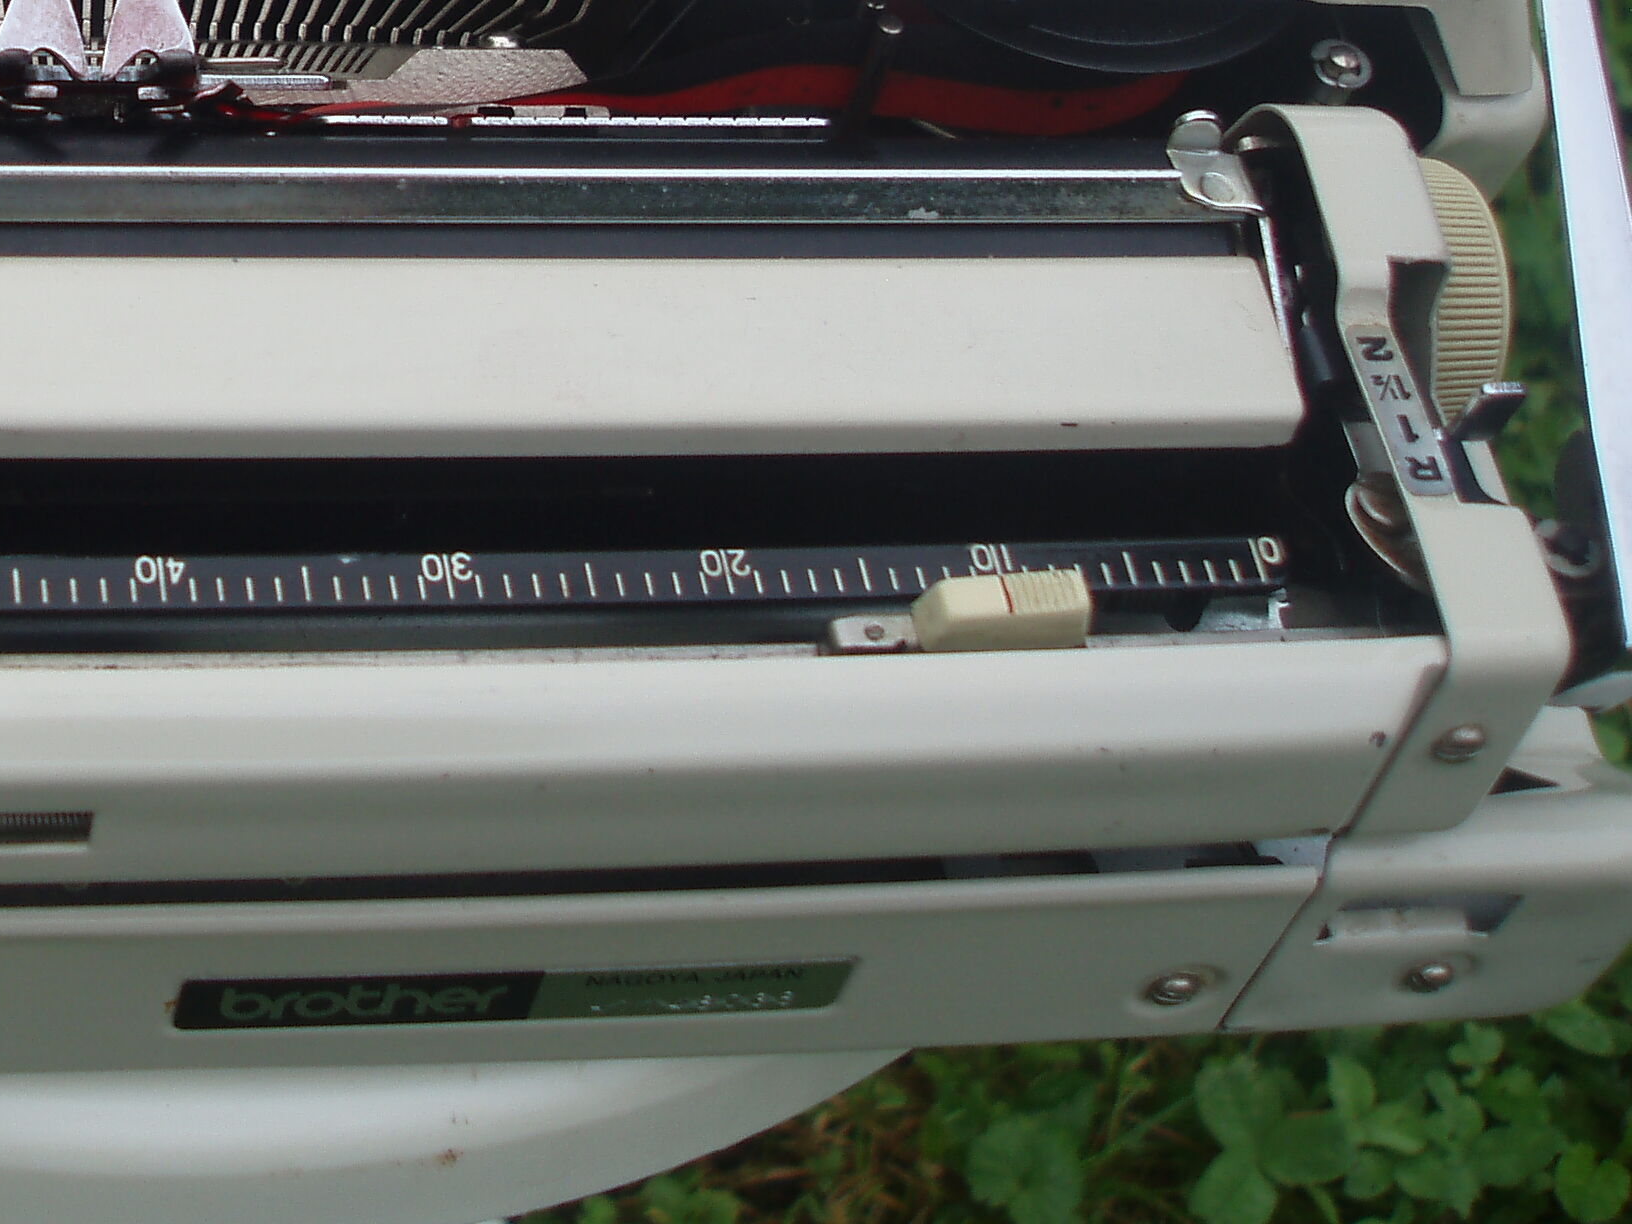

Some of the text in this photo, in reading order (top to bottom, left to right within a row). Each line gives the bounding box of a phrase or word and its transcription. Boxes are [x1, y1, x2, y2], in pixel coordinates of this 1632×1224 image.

[1355, 336, 1394, 362] 2
[1397, 414, 1420, 443] 1
[1404, 455, 1444, 482] R
[133, 554, 187, 584] 40
[420, 552, 474, 583] 30
[699, 547, 751, 578] 20
[218, 982, 508, 1021] brother
